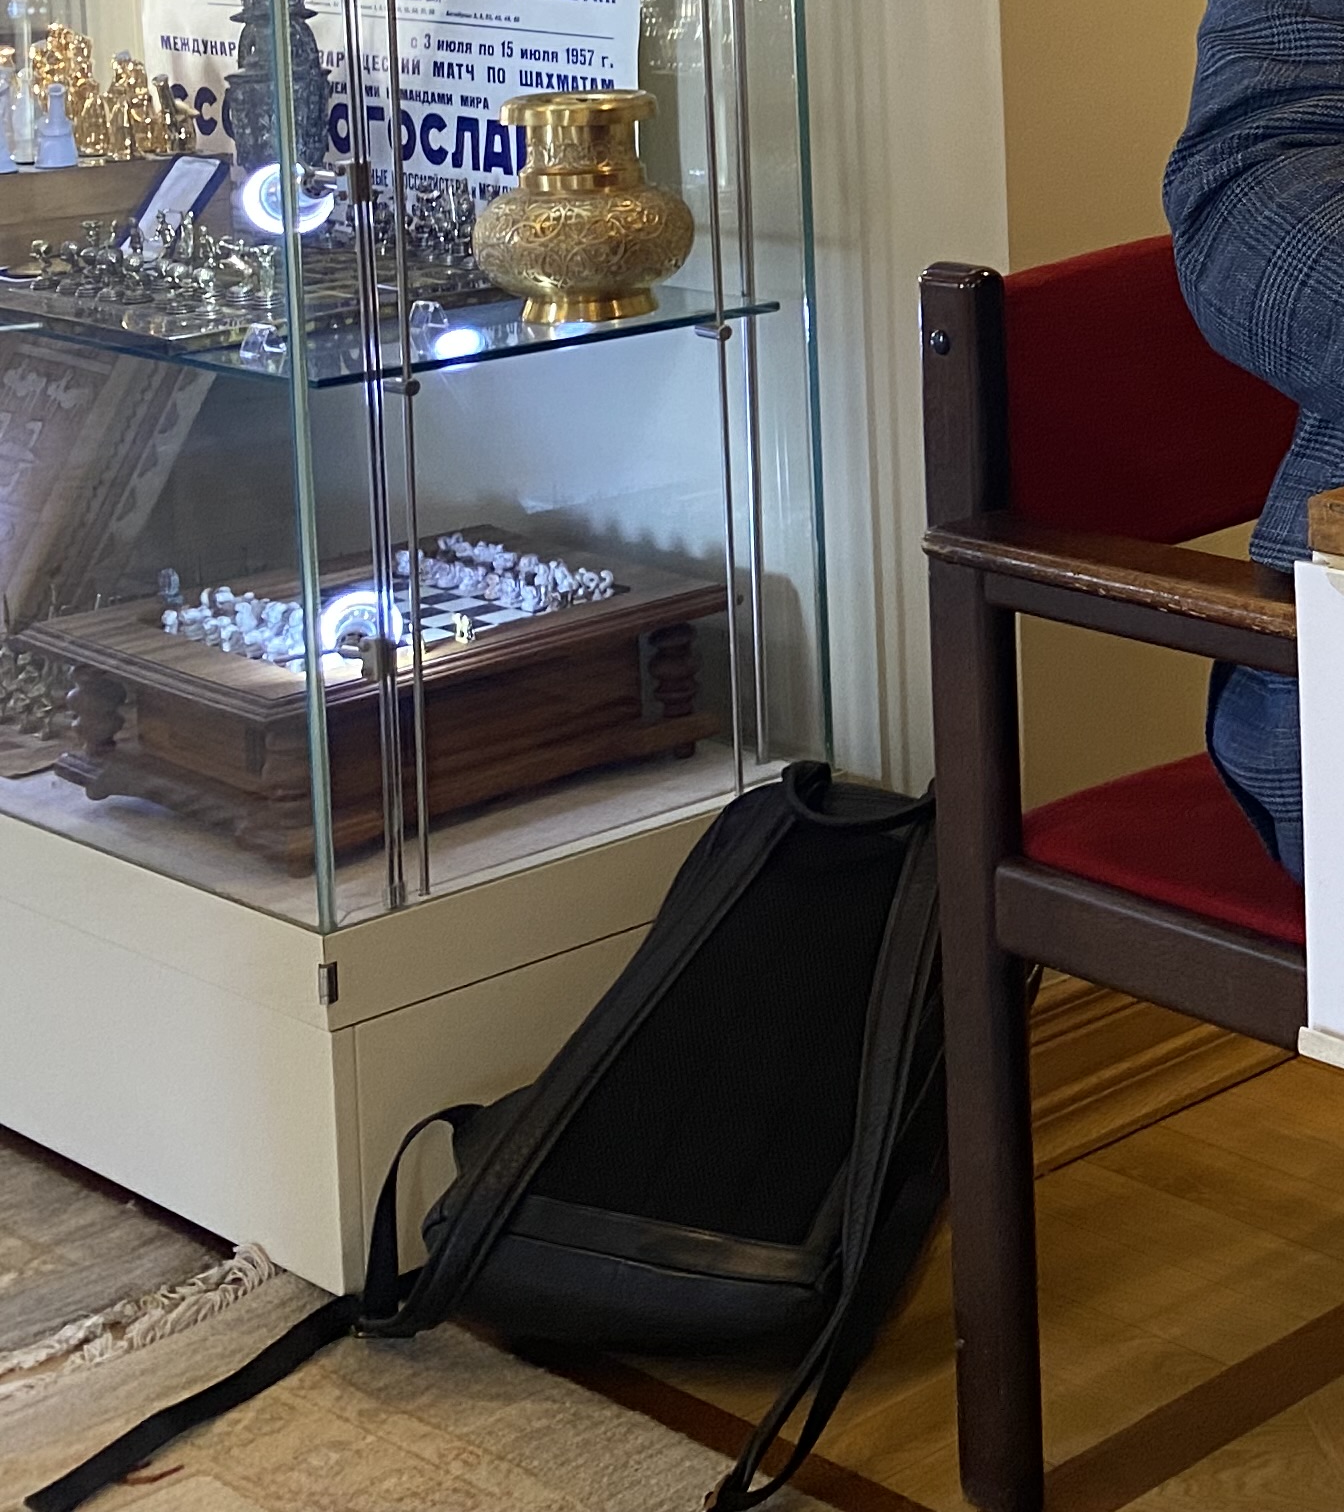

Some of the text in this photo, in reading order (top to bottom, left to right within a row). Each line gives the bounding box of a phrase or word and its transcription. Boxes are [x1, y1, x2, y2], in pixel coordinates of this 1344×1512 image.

[161, 35, 237, 57] МЕЖДУНАР
[432, 60, 475, 81] МАТЧ
[486, 66, 506, 84] ПО
[519, 70, 615, 92] ШАХМАТАМ
[423, 33, 431, 50] 3
[436, 38, 473, 55] июля
[478, 43, 495, 57] по
[500, 40, 514, 58] 15
[520, 47, 559, 64] июля
[565, 46, 595, 66] 1957
[601, 55, 614, 69] г.
[460, 94, 490, 110] МИРА
